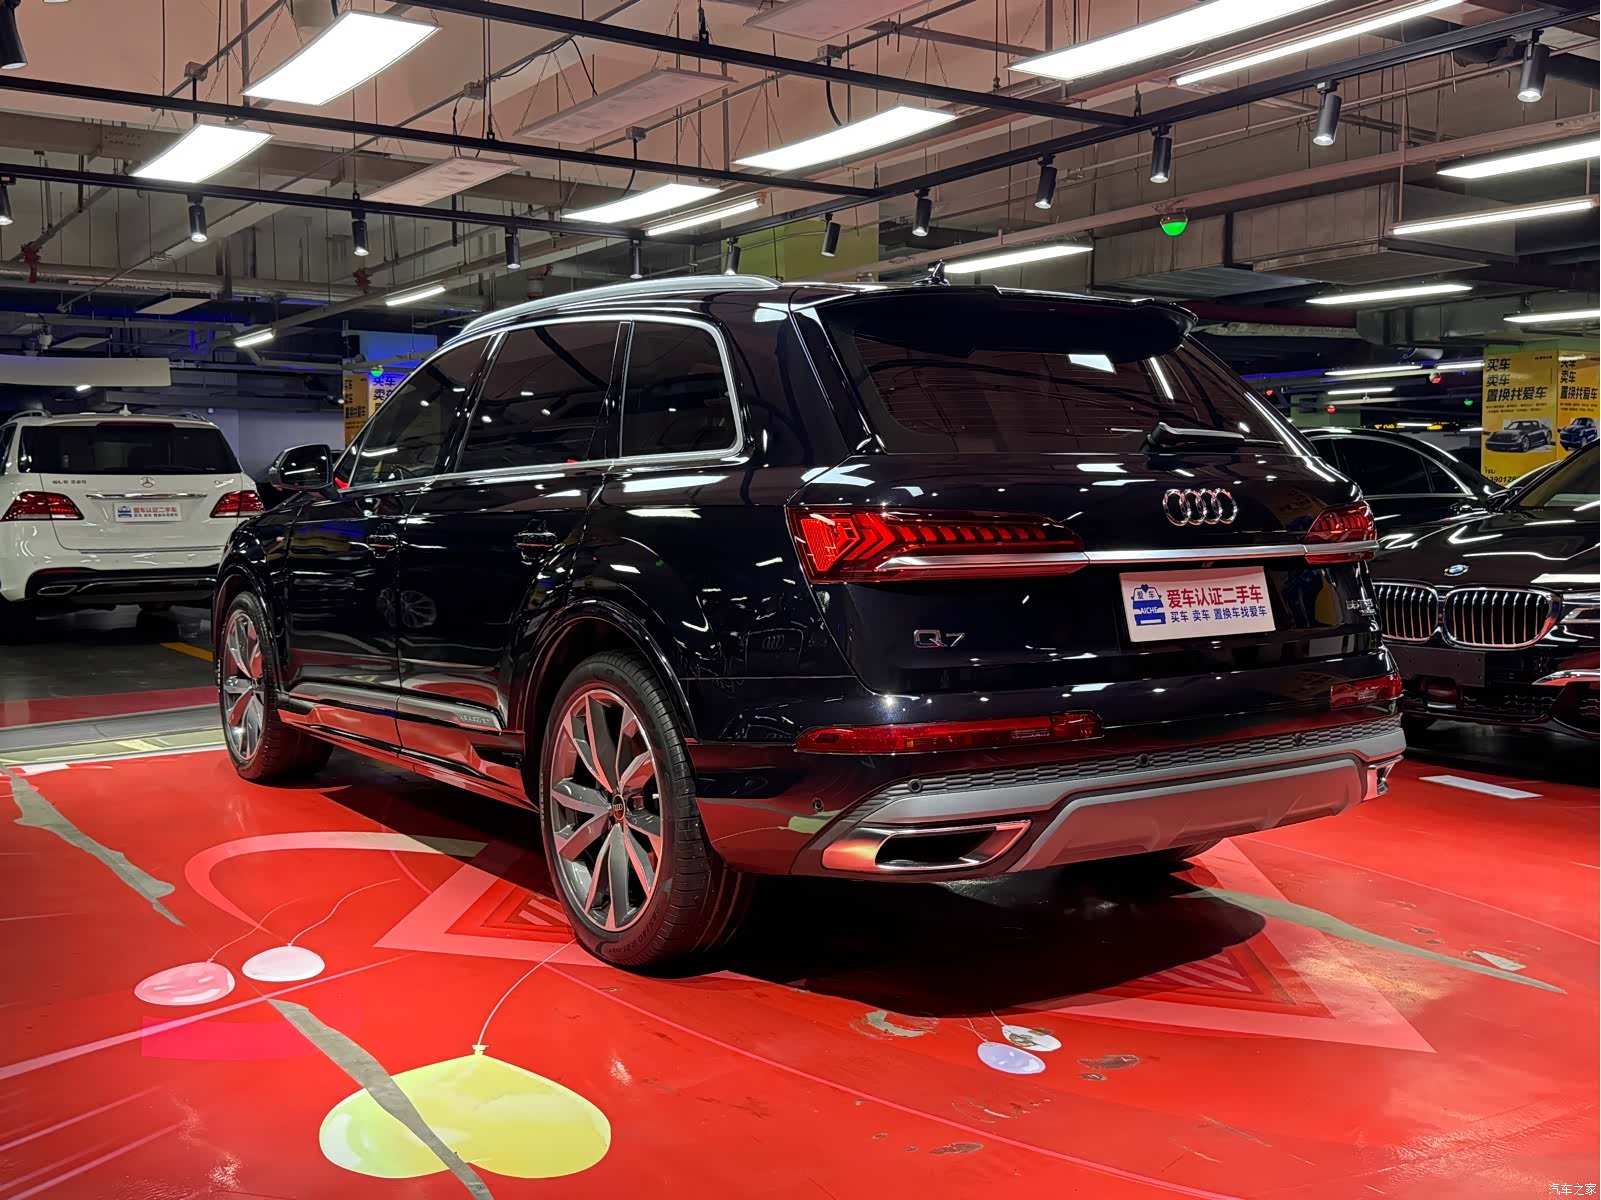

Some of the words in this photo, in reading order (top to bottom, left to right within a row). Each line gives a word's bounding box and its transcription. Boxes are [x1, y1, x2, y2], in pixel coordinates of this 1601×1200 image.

[1487, 358, 1511, 371] 买车
[1486, 373, 1511, 387] 卖车
[1560, 370, 1576, 384] 卖车
[1486, 386, 1548, 402] 置换找爱车
[1167, 585, 1264, 609] 爱车认证二手车
[1170, 610, 1189, 624] 买车
[1192, 609, 1211, 622] 卖车
[1213, 605, 1268, 620] 置换车找爱车
